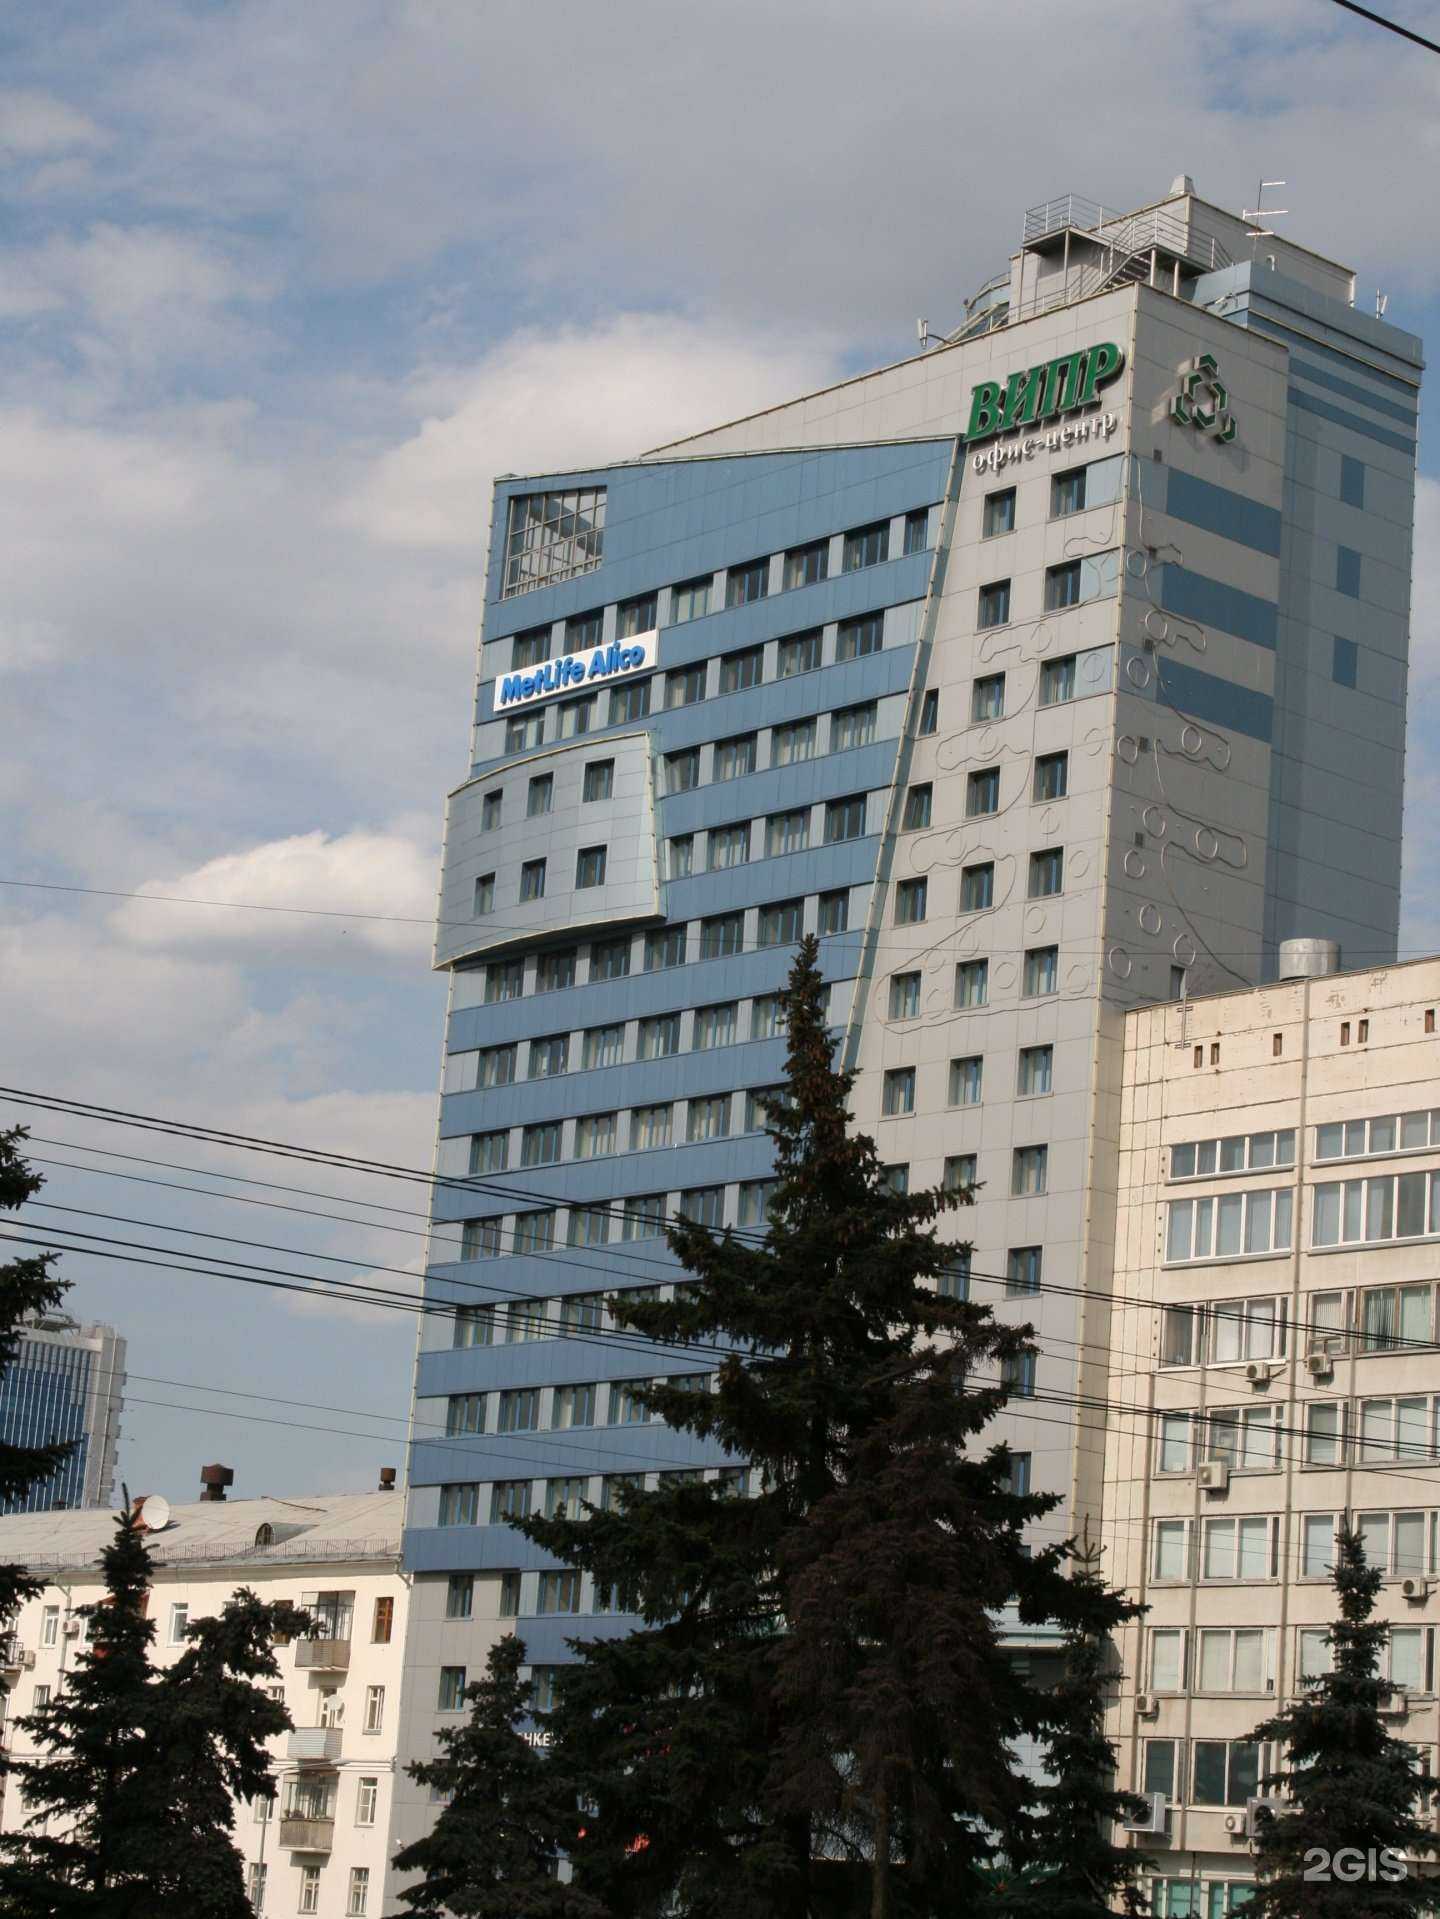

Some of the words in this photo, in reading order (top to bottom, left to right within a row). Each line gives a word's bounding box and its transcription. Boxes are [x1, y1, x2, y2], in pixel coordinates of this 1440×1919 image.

[963, 342, 1124, 443] ВИПР
[972, 412, 1114, 471] офис-центр
[501, 656, 586, 704] MetLife
[587, 640, 646, 679] Alico
